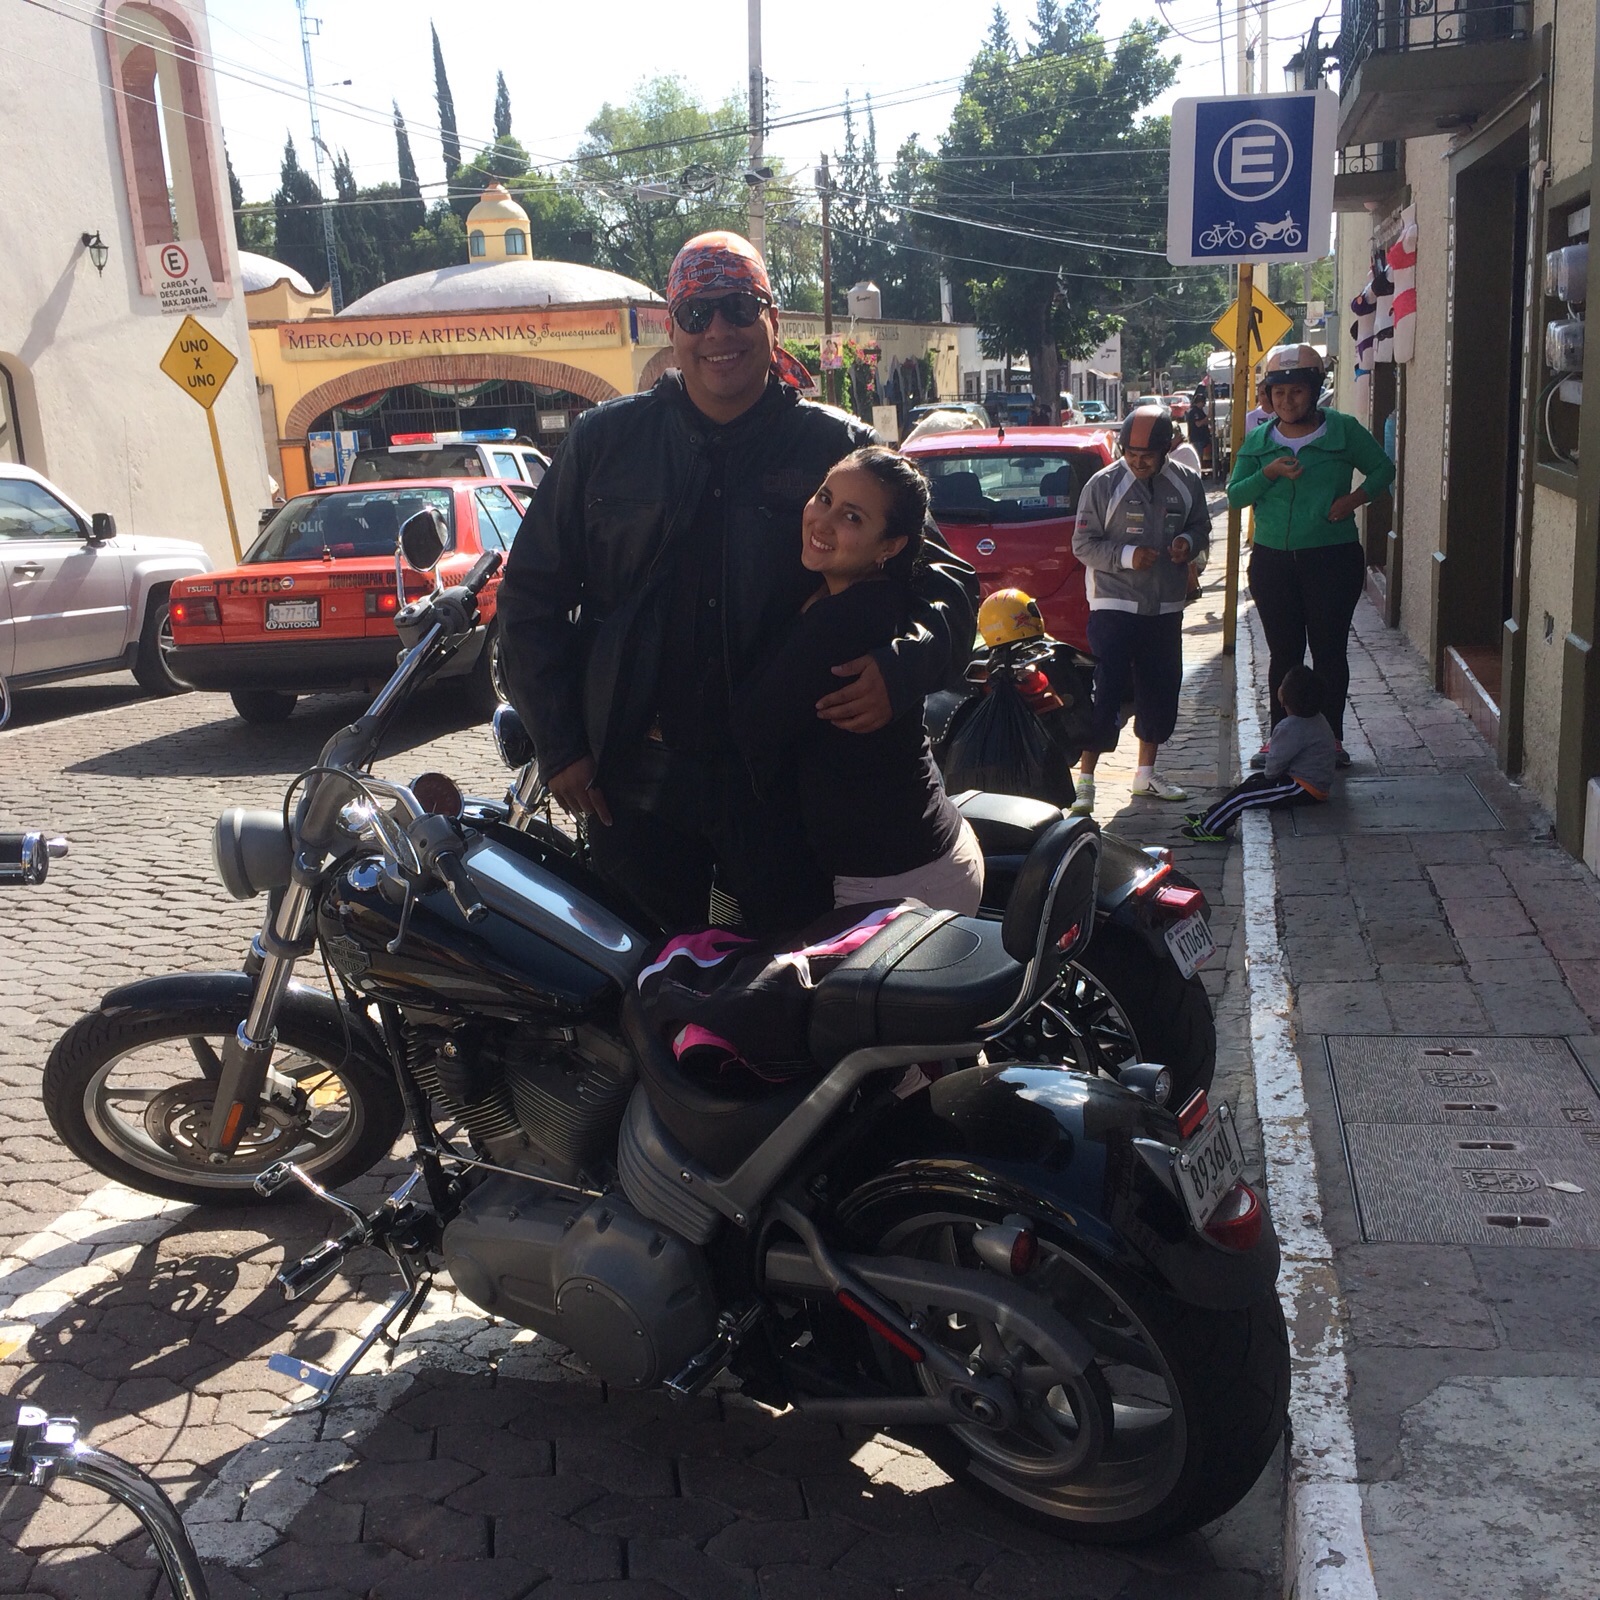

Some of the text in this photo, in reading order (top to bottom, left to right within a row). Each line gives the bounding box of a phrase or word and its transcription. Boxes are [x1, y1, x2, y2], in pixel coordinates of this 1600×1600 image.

[1231, 135, 1276, 184] E
[167, 252, 181, 271] E
[161, 278, 198, 290] CARGA Y
[160, 286, 207, 298] DESCARGA
[162, 299, 180, 308] MAX.
[180, 297, 191, 305] 20
[191, 295, 211, 304] MIN.
[288, 331, 383, 350] MERCADO
[389, 329, 414, 346] DE
[418, 324, 537, 345] ARTESANIAS
[180, 338, 209, 353] UNO
[193, 357, 203, 370] X
[187, 373, 216, 388] UNO
[278, 620, 320, 629] AUTOCOM
[1190, 1126, 1232, 1200] 8936U
